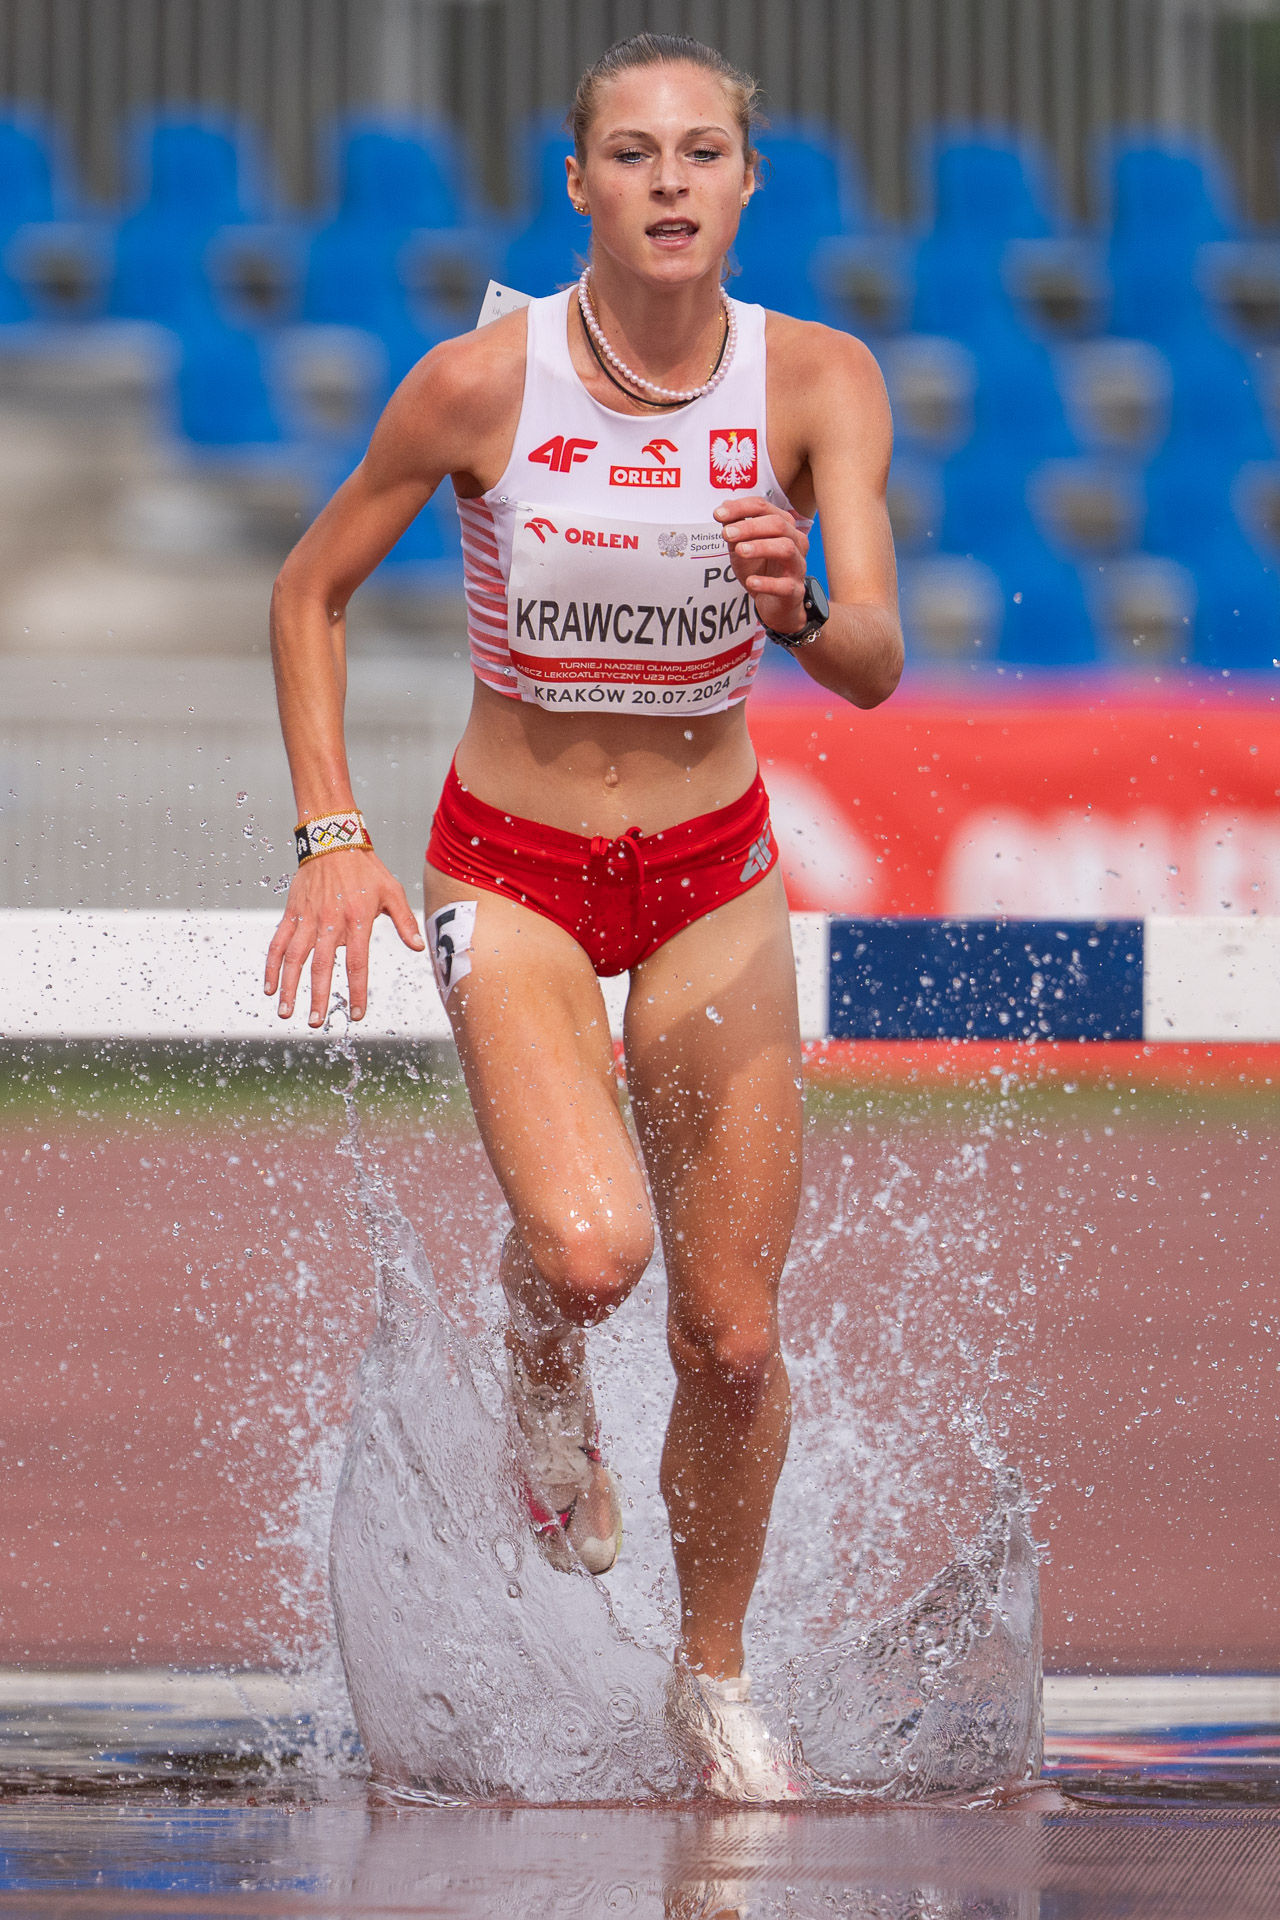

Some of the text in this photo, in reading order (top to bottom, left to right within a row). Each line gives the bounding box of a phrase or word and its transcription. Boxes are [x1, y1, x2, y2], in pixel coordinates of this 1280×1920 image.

[528, 435, 598, 473] 4F
[613, 469, 676, 485] ORLEN
[565, 528, 639, 550] ORLEN
[690, 542, 720, 551] Sportu
[704, 564, 737, 588] PO
[516, 593, 751, 647] KRAWCZYŃSKA
[517, 663, 542, 677] MECZ
[544, 671, 641, 680] LEKKOATLETYCZNY
[643, 673, 665, 681] U23
[605, 663, 645, 671] NADZIEI
[647, 660, 715, 672] OLIMPIJSKICH
[534, 675, 730, 704] KRAKÓW 20.07.2024
